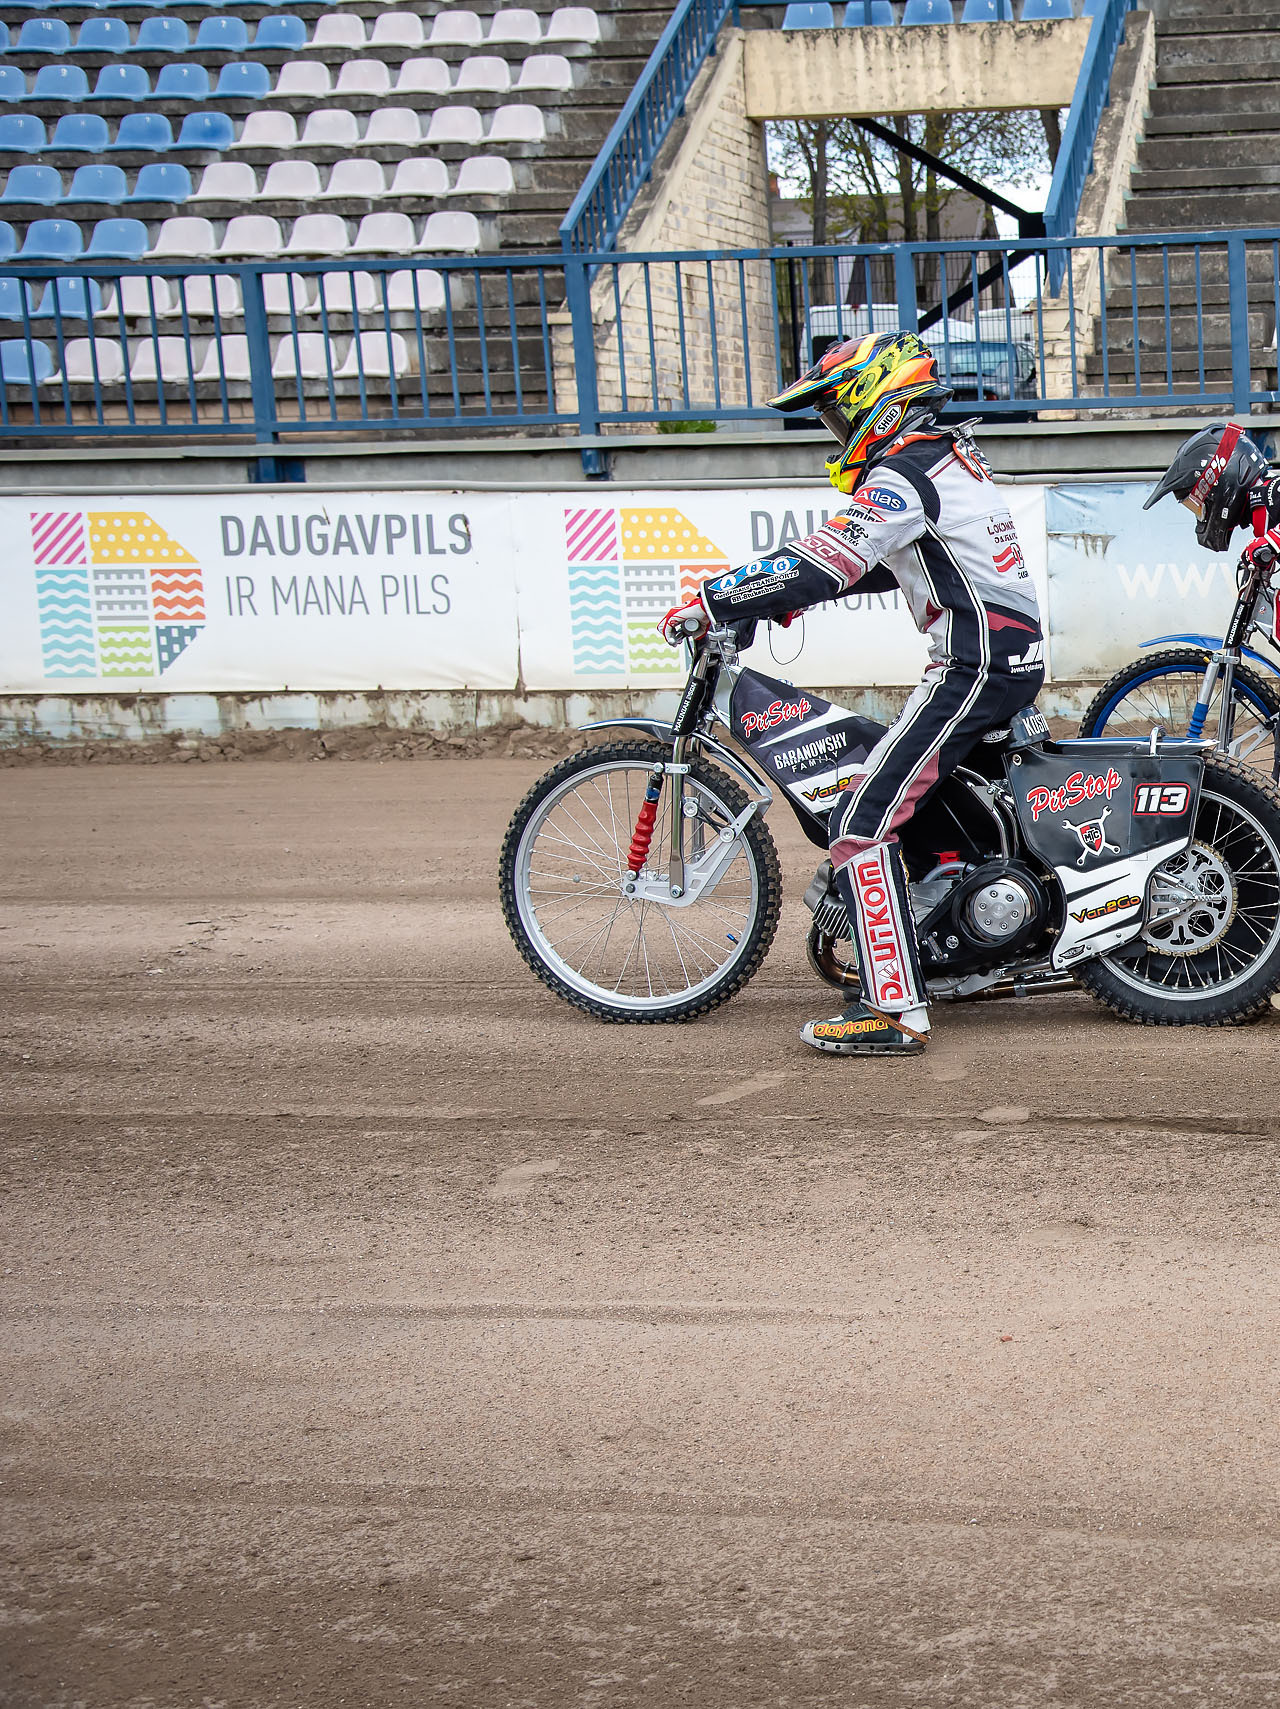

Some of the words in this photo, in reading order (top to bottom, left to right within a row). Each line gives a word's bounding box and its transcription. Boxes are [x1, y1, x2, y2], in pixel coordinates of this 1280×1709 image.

[877, 407, 901, 433] SHOEI
[855, 489, 902, 509] Atlas
[220, 512, 473, 556] DAUGAVPILS
[226, 575, 259, 617] IR
[272, 575, 370, 617] MANA
[381, 573, 452, 616] PILS
[741, 697, 812, 738] PitStop
[791, 750, 839, 774] FAMILY
[801, 773, 854, 801] Van2
[1026, 767, 1123, 822] PitStop
[1133, 783, 1191, 815] 113
[1069, 894, 1142, 924] Van2Go
[813, 1018, 889, 1039] daytona
